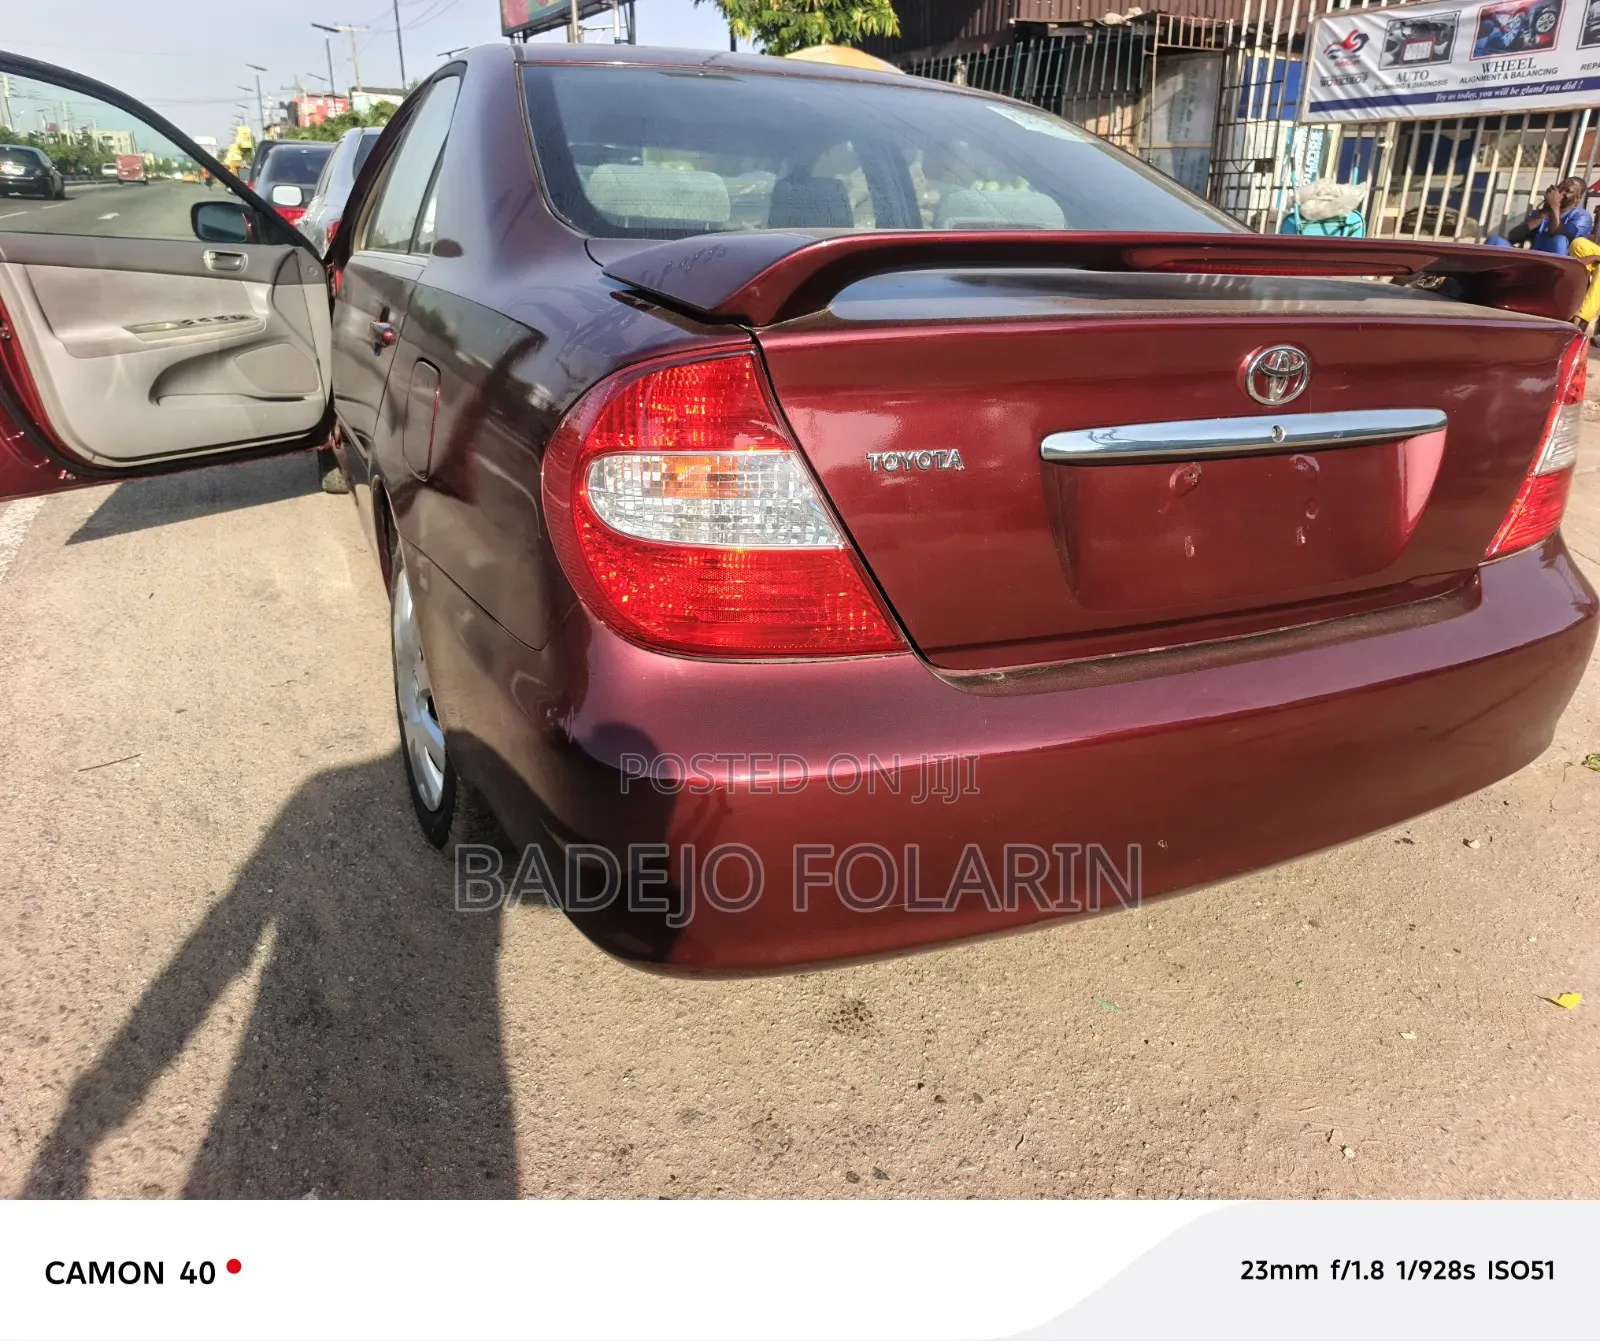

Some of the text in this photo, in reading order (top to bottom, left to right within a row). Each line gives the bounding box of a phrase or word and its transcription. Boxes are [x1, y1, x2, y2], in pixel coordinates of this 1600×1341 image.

[1481, 57, 1537, 74] WHEEL
[1395, 70, 1429, 82] AUTO
[1412, 79, 1448, 88] DIAGNOSIS
[1459, 74, 1504, 84] ALIGNMENT
[1510, 67, 1558, 79] BALANCING
[1435, 93, 1447, 102] Try
[1479, 91, 1493, 100] you
[1494, 87, 1508, 96] will
[1510, 86, 1518, 95] be
[1520, 84, 1543, 96] gland
[1544, 84, 1561, 94] you
[1562, 80, 1577, 90] did
[866, 449, 965, 472] TOYOTA
